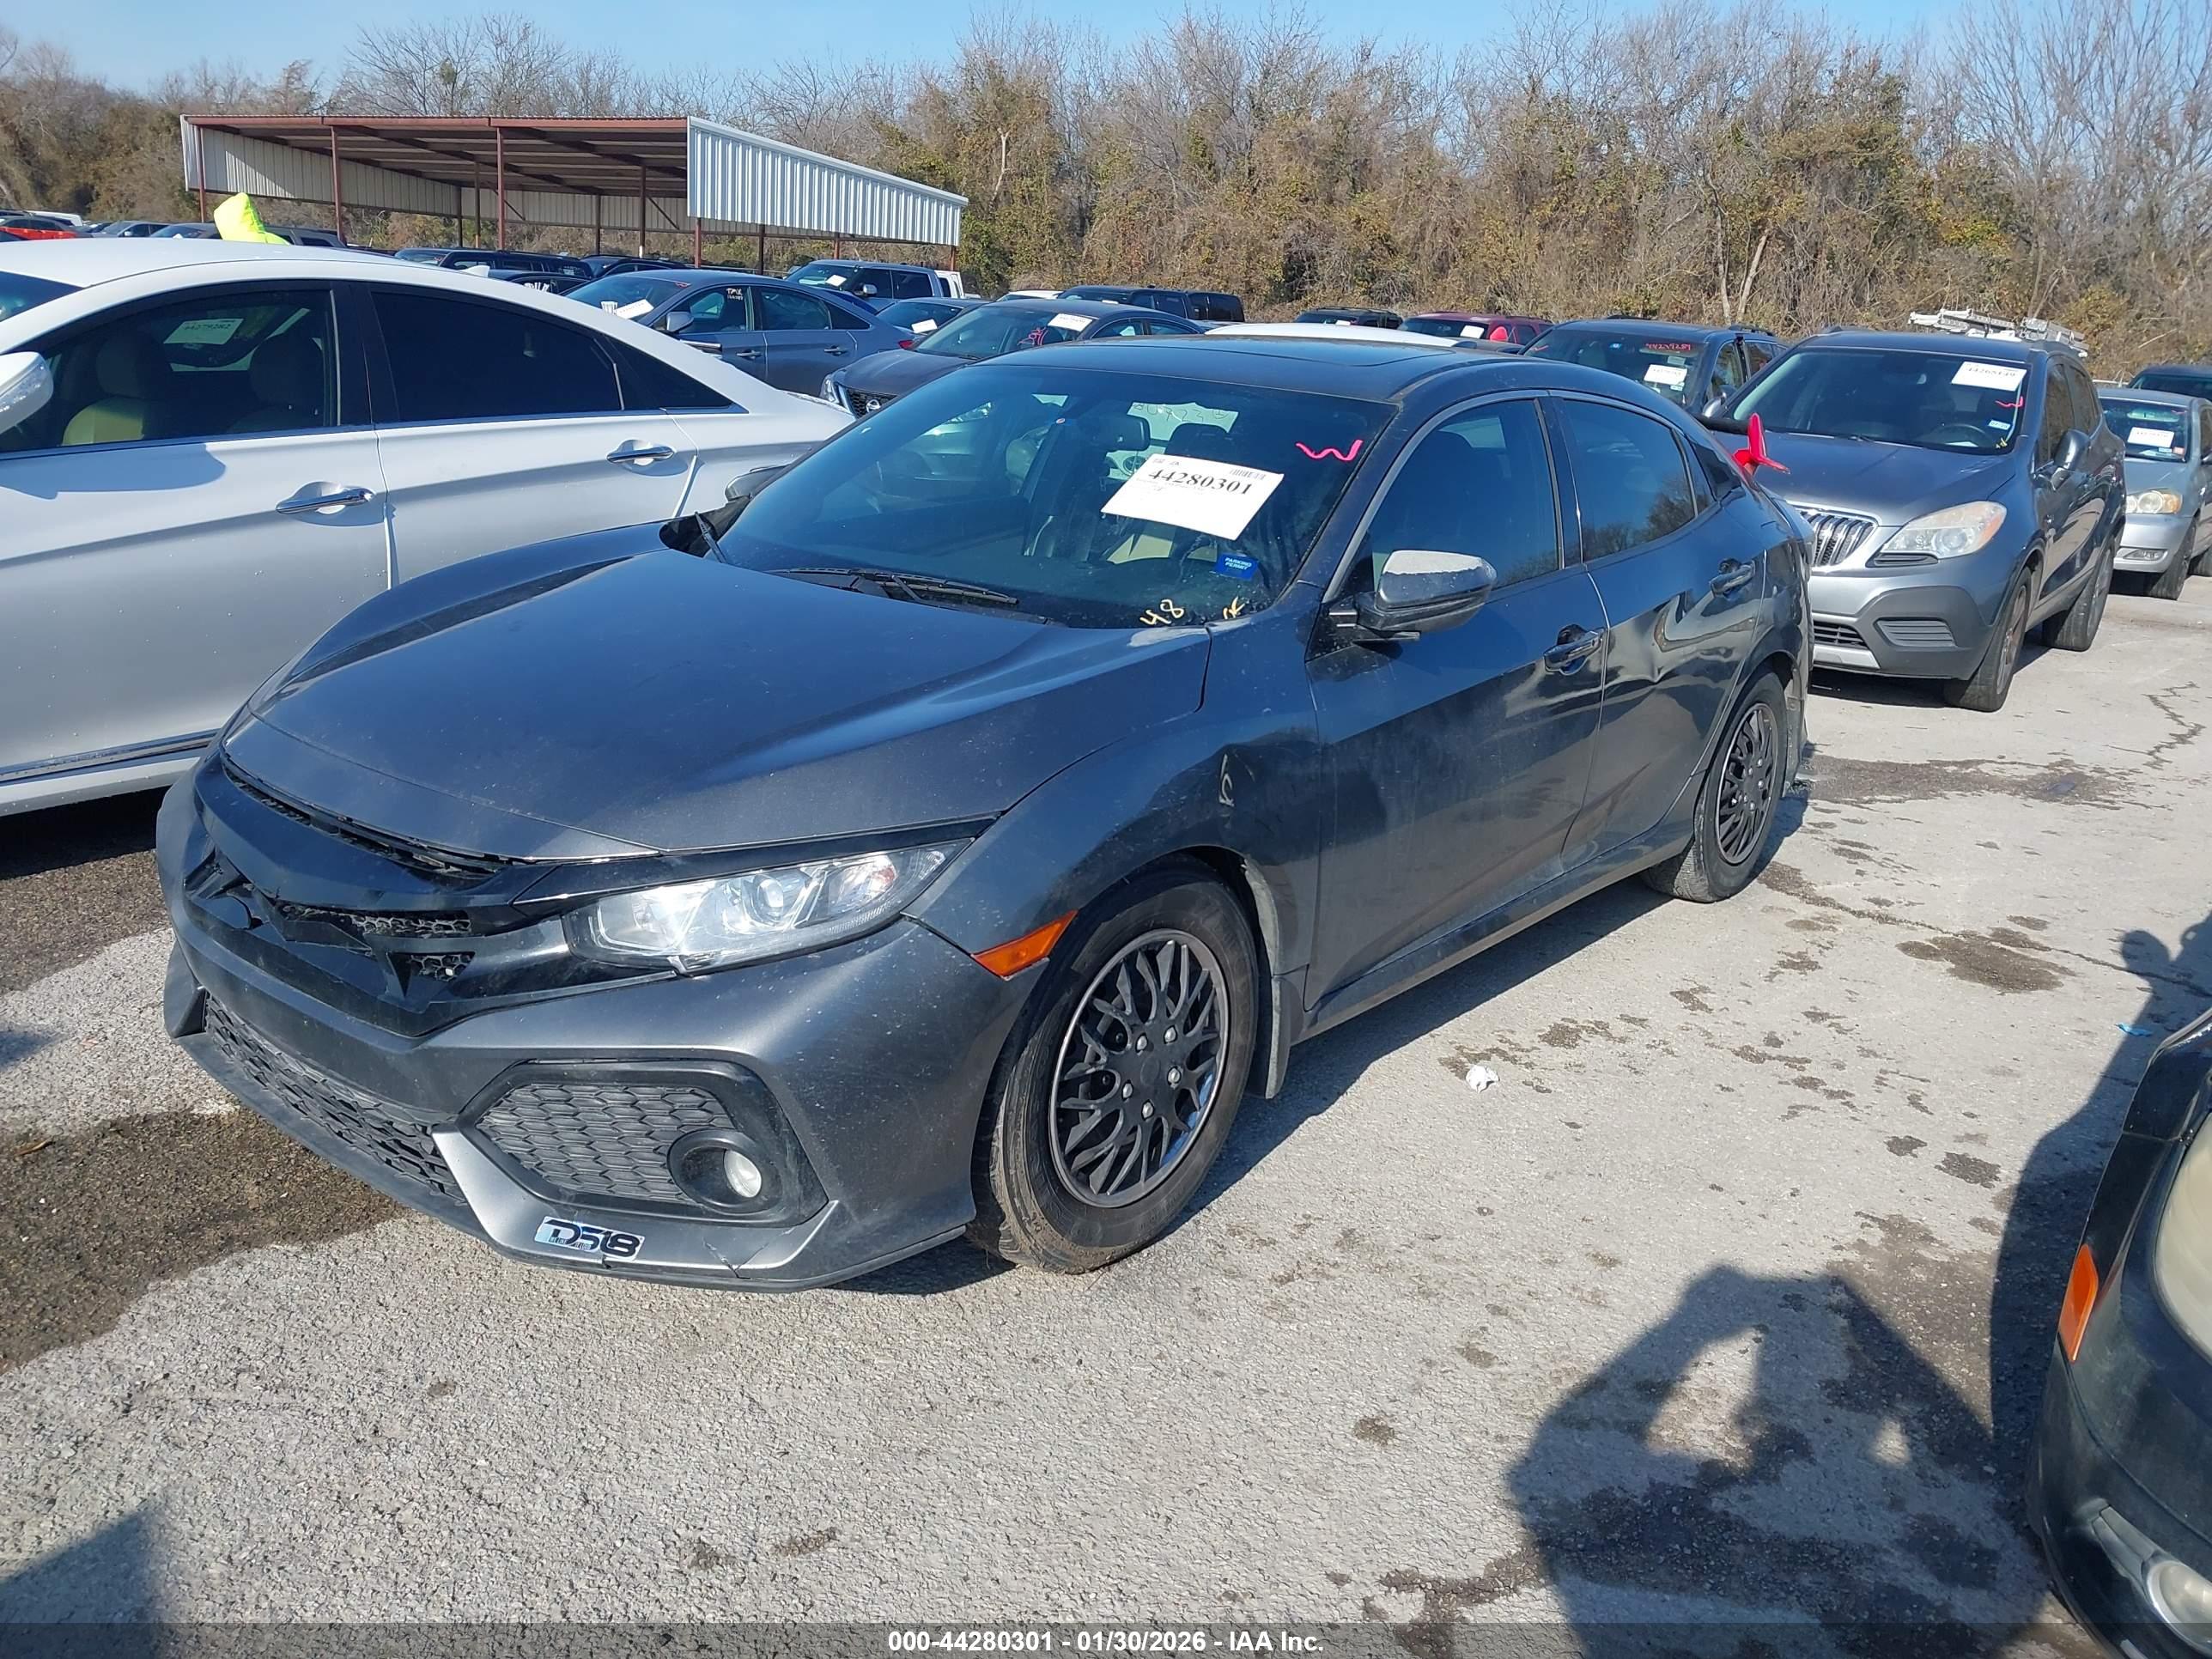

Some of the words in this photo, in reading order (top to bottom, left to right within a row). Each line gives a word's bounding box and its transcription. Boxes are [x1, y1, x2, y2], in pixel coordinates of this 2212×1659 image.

[1147, 468, 1253, 495] 44280301
[1224, 556, 1253, 568] PARKING
[1224, 562, 1249, 571] PERMIT
